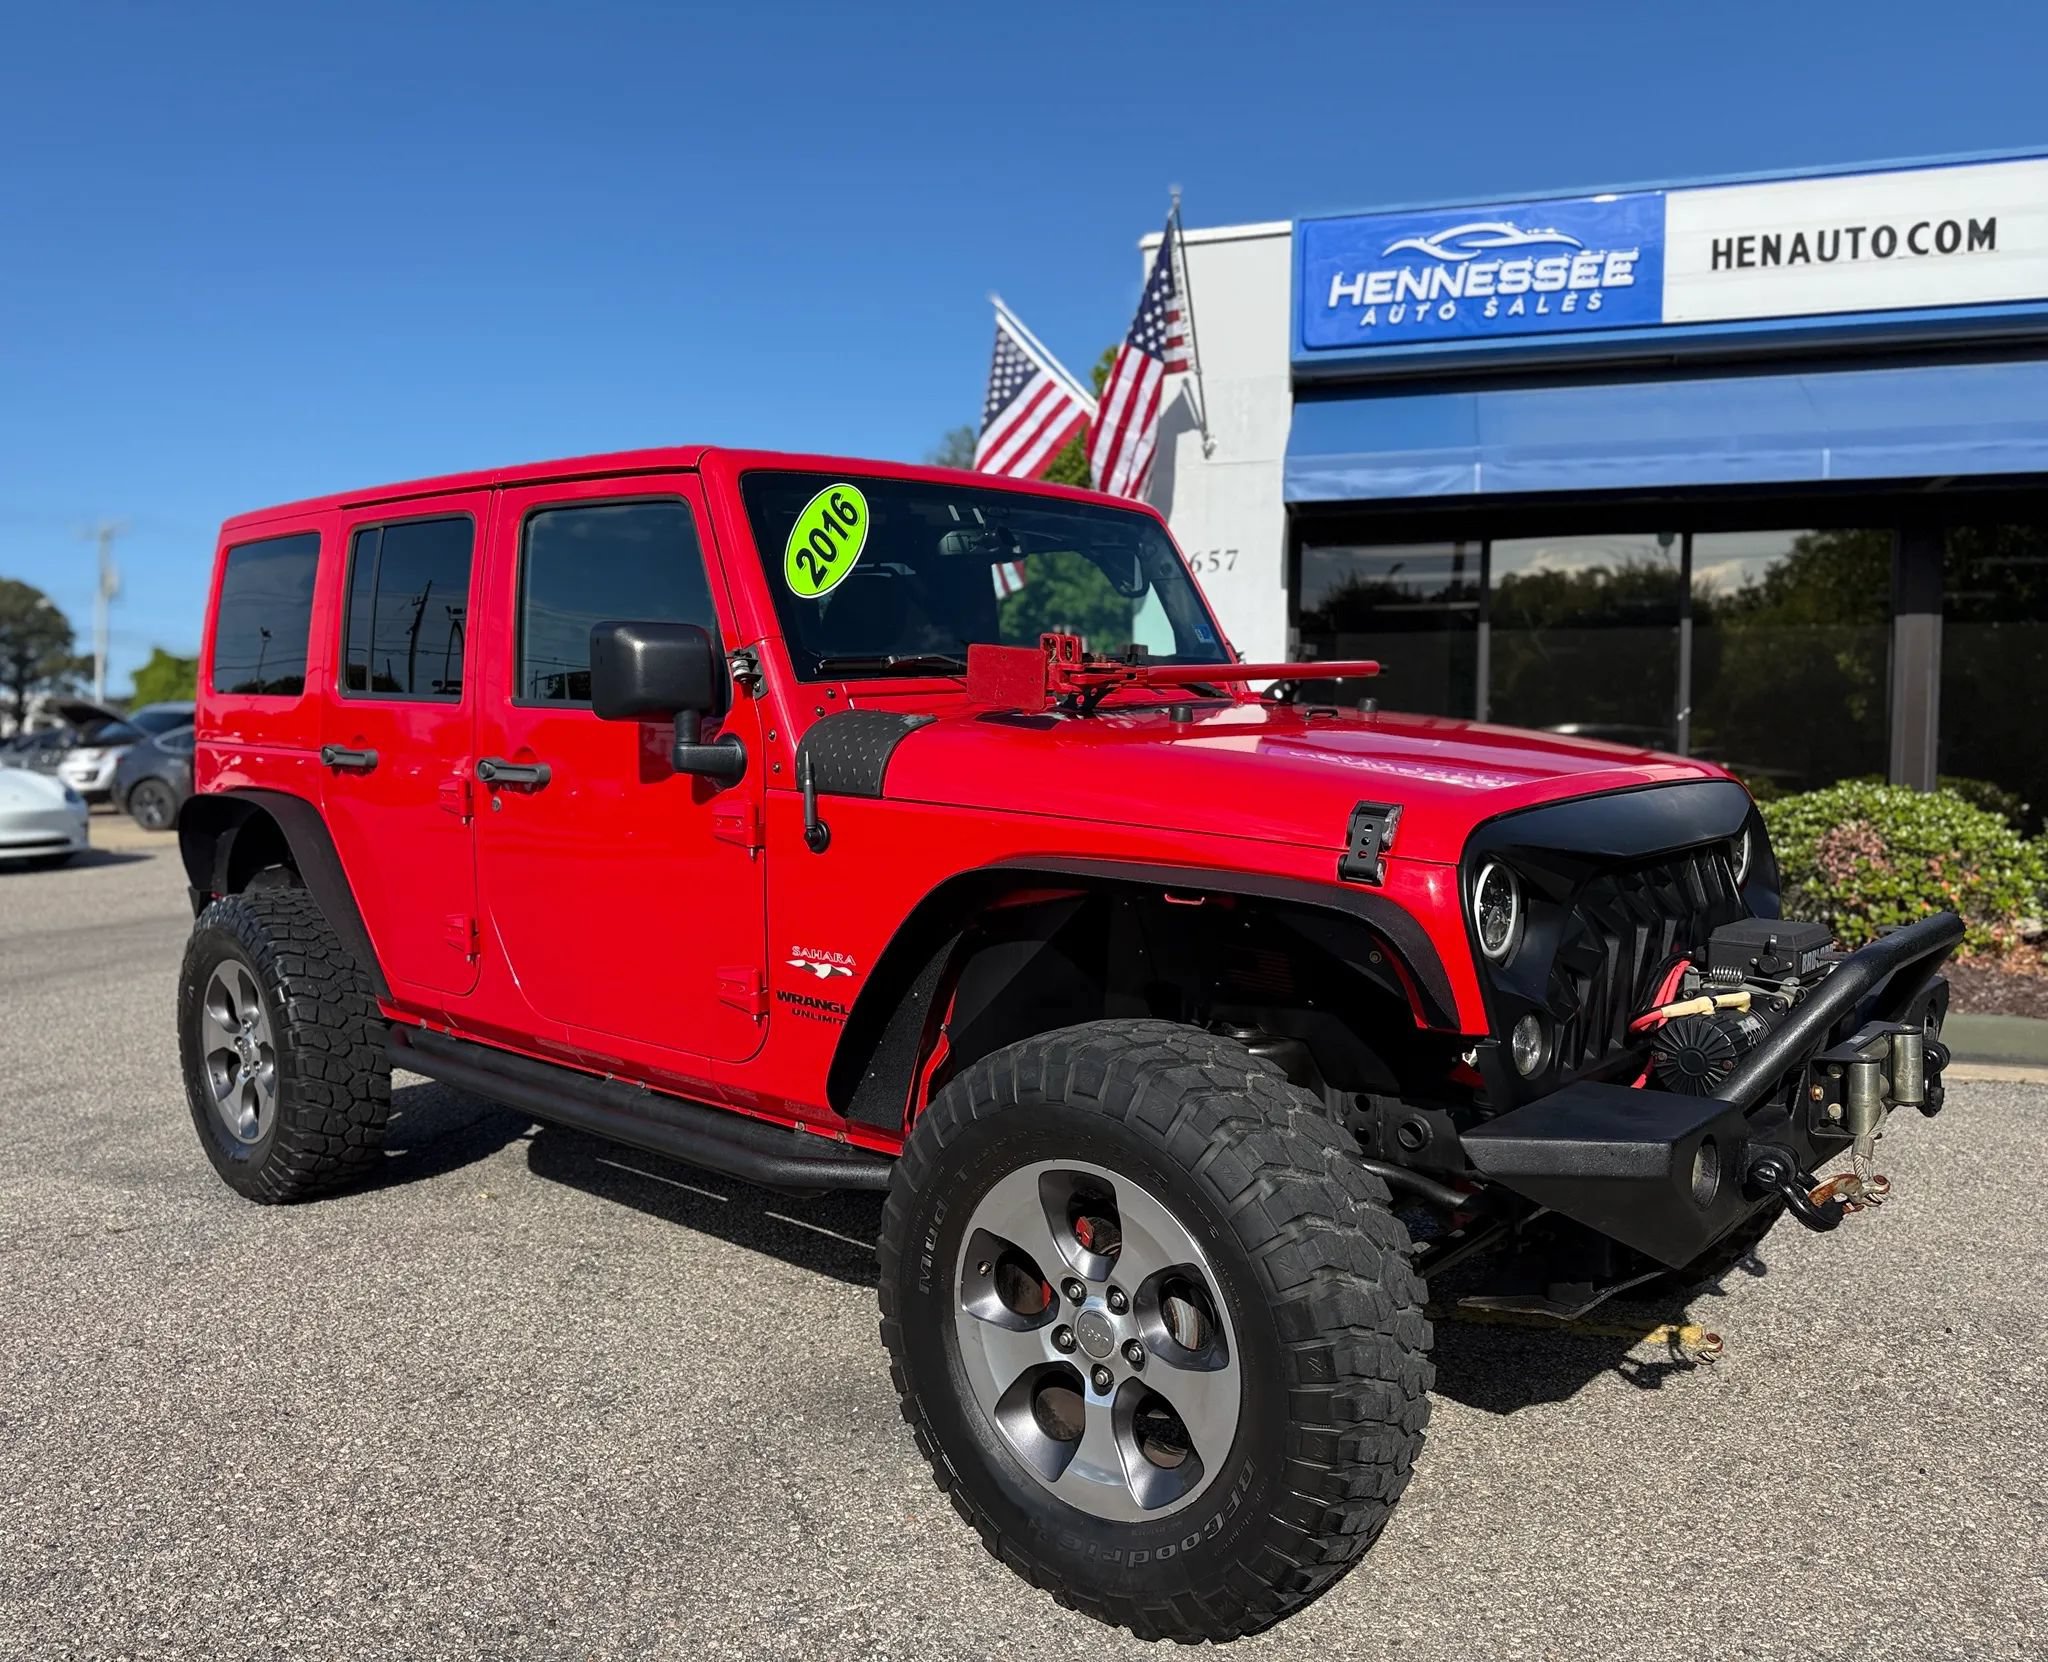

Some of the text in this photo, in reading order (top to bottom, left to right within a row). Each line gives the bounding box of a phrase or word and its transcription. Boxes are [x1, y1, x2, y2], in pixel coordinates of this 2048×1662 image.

[1328, 247, 1640, 308] HENNESSEE
[1360, 290, 1603, 327] AUTO SALES
[796, 492, 860, 589] 2016
[1189, 549, 1239, 573] 657
[792, 945, 857, 966] SAHARA
[777, 990, 850, 1015] WRANGL
[791, 1008, 847, 1026] UNLIMIT
[1032, 1456, 1257, 1569] BFGoodric
